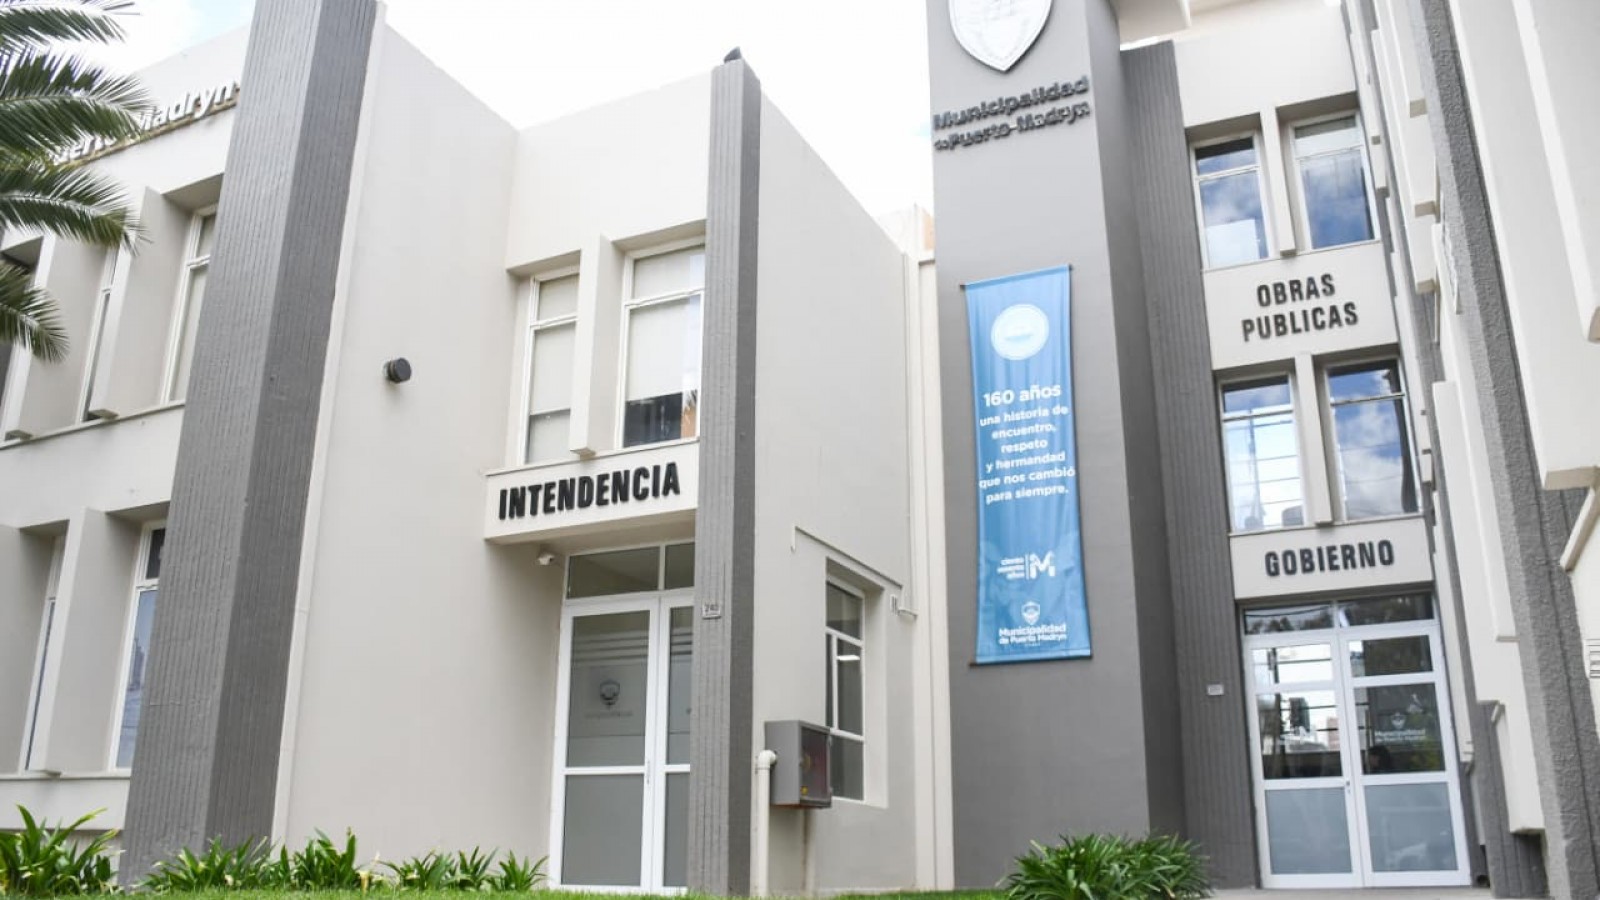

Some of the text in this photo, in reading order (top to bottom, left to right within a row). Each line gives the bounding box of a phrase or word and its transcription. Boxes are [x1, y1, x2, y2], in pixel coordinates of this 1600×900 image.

[933, 76, 1089, 130] Municipalidad
[949, 122, 1013, 151] Puerto
[1017, 101, 1091, 132] Madryn
[1256, 273, 1336, 308] OBRAS
[1240, 301, 1359, 342] PUBLICAS
[983, 383, 1062, 407] 160 años
[980, 403, 1069, 426] una historia de
[991, 421, 1057, 440] encuentro,
[1001, 439, 1048, 454] respeto
[985, 450, 1066, 473] y hermandad
[979, 465, 1075, 490] que nos cambió
[498, 461, 681, 521] INTENDENCIA
[985, 484, 1069, 505] para siempre.
[1264, 539, 1395, 578] GOBIERNO
[999, 623, 1066, 636] Municipalidad
